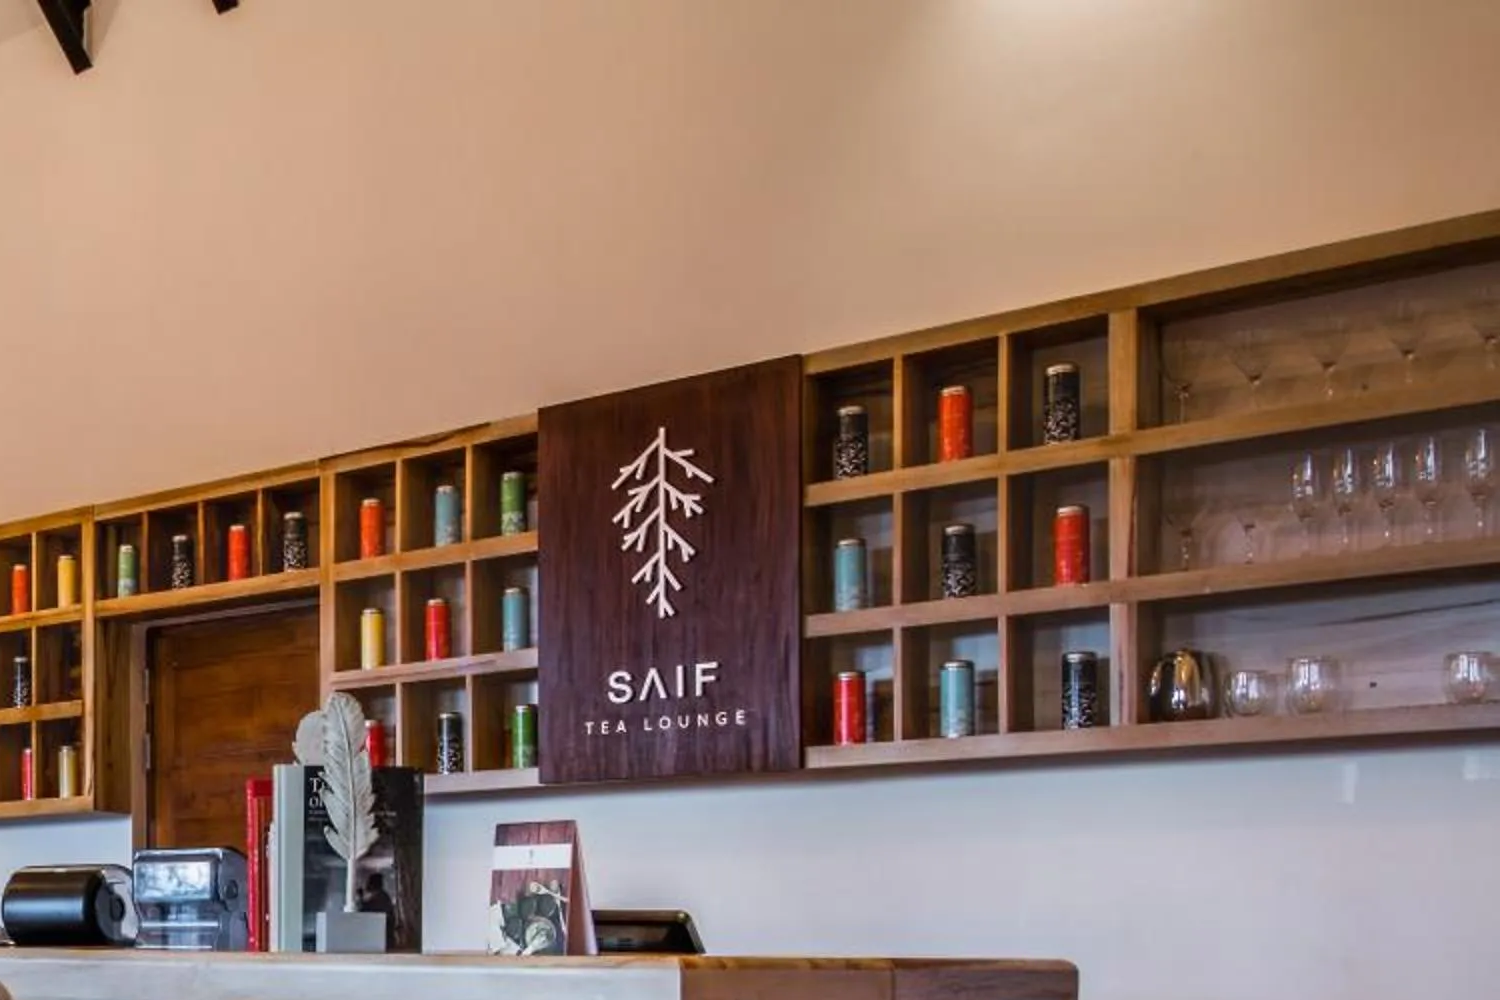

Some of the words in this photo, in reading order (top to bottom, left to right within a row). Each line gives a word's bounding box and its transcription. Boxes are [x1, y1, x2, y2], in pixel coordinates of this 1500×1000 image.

[607, 661, 719, 704] SAIF
[584, 720, 627, 736] TEA
[643, 709, 748, 732] LOUNGE
